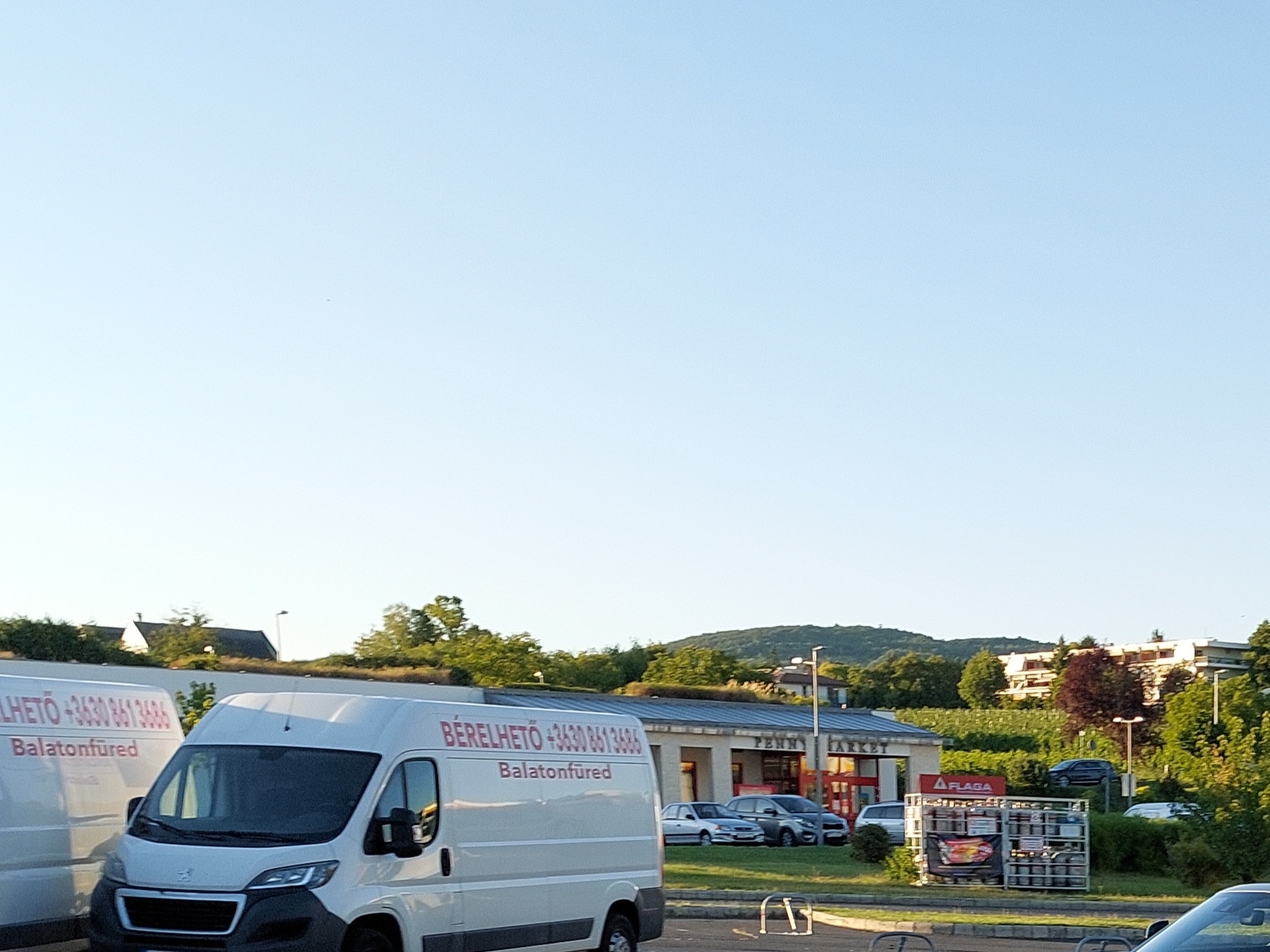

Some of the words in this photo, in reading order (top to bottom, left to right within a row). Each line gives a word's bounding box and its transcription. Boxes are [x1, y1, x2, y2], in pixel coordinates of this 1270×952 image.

[0, 691, 60, 725] LHETŐ
[440, 715, 542, 750] BÉRELHETŐ
[11, 737, 139, 758] Balatonfüred
[498, 761, 612, 780] Balatonfüred
[949, 782, 992, 791] FLAGA
